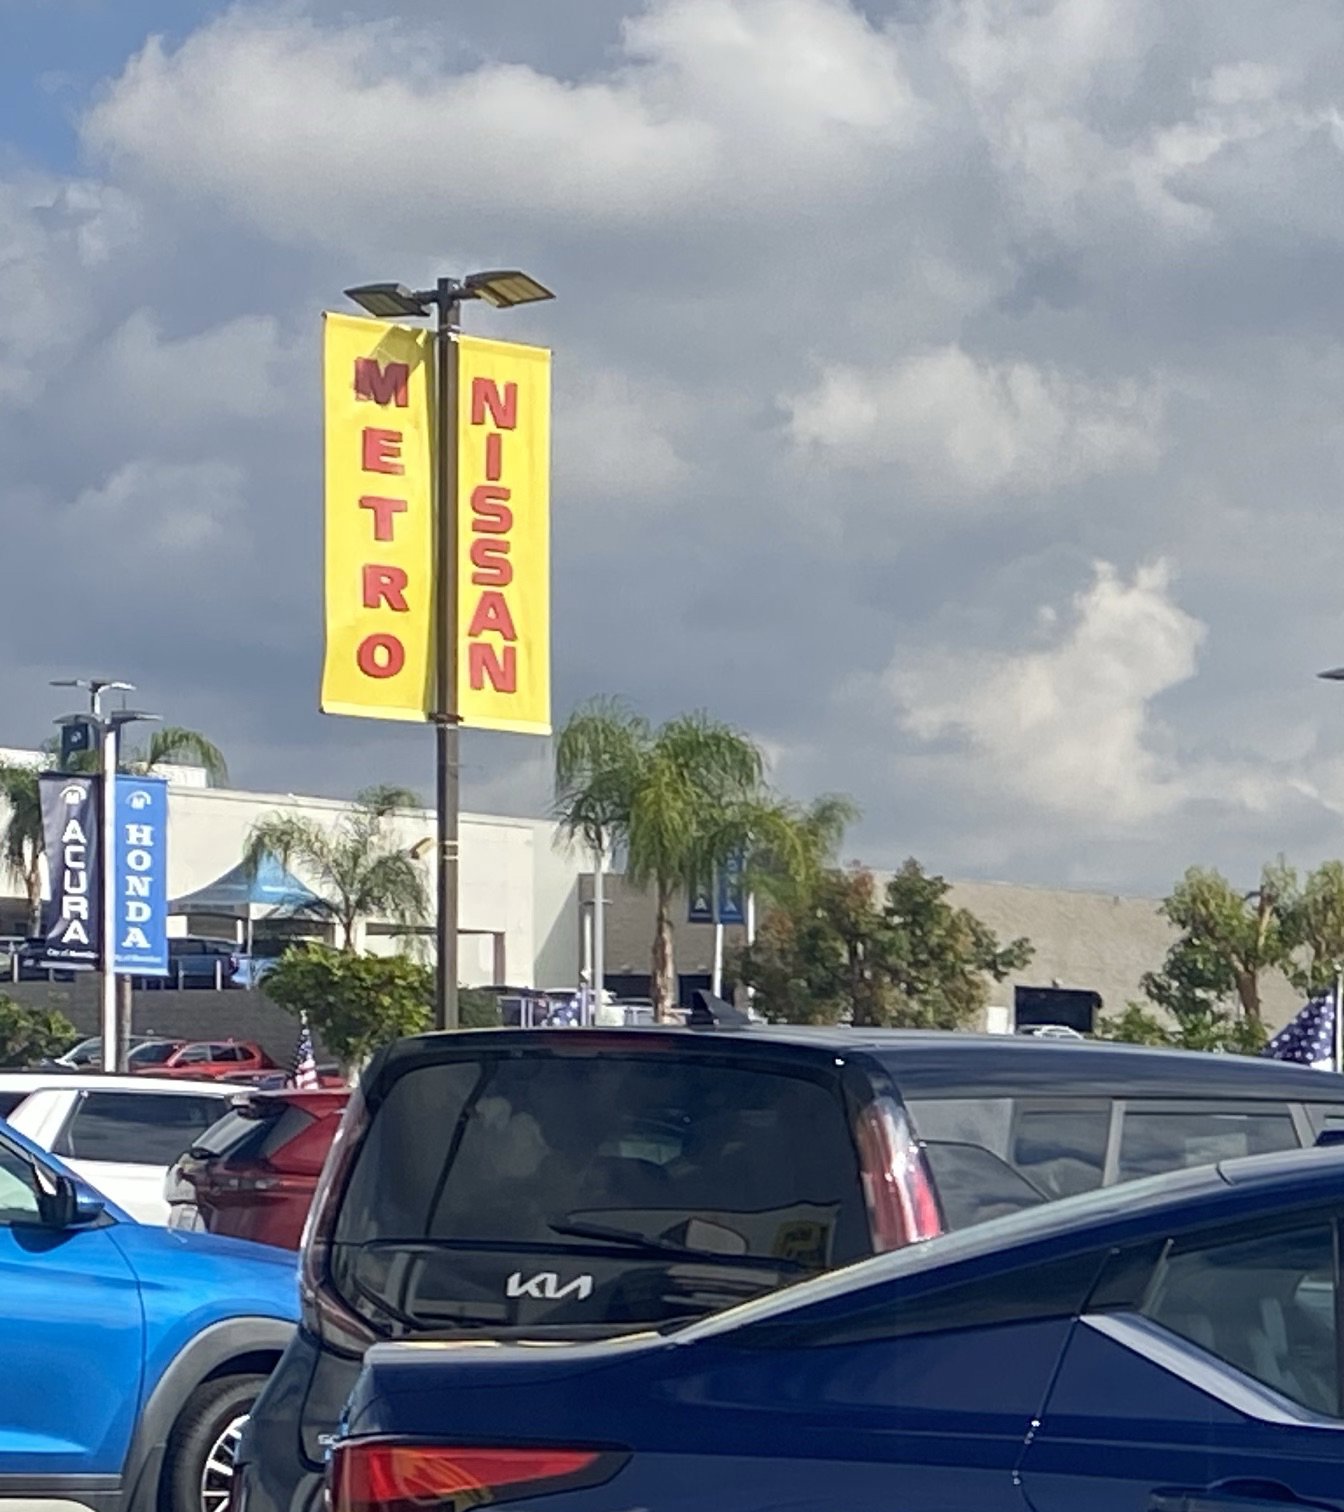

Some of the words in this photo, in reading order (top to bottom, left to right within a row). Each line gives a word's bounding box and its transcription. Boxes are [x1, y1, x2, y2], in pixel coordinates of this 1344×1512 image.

[354, 358, 410, 679] METRO
[467, 376, 518, 694] NISSAN
[61, 818, 89, 945] ACURA
[121, 823, 155, 949] HONDA
[506, 1271, 593, 1300] KIA
